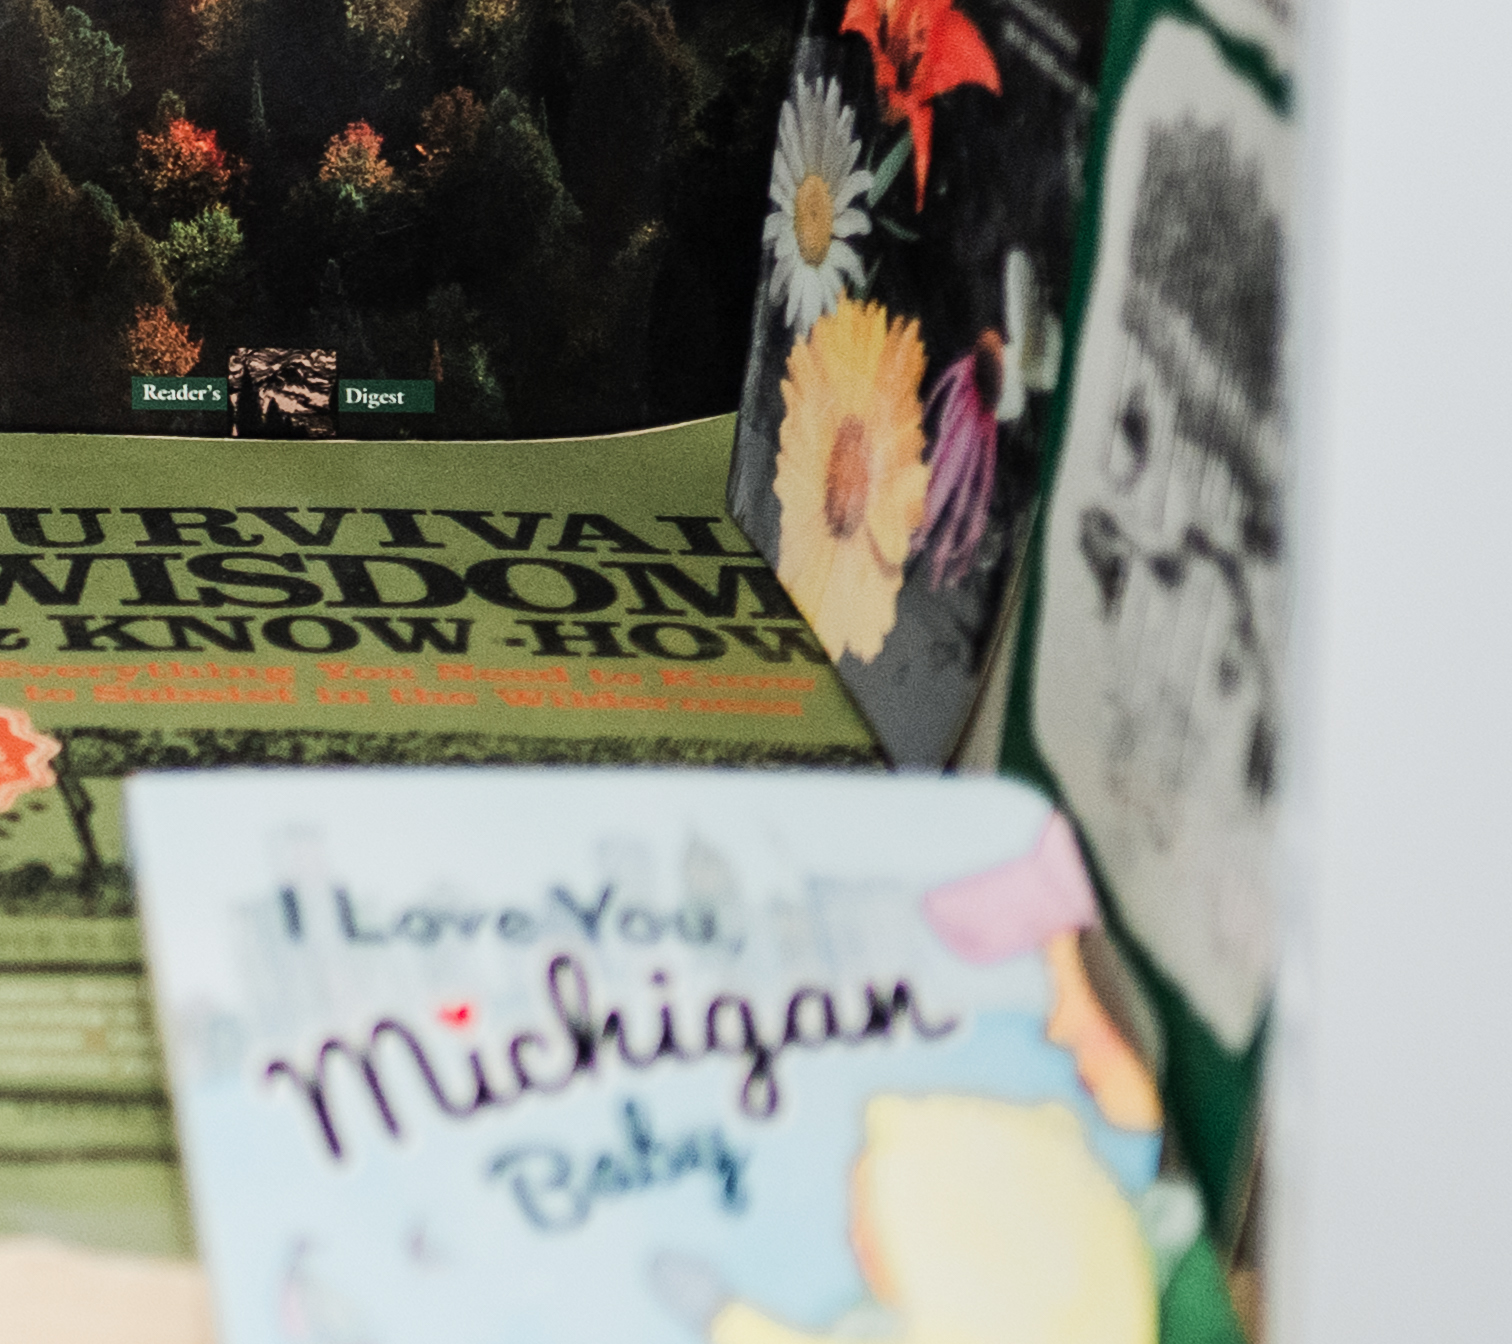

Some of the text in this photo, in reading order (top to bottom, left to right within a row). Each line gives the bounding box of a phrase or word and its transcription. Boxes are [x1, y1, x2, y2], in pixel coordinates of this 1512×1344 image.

[142, 384, 405, 409] Reader's Digest
[24, 683, 77, 703] to
[316, 684, 370, 705] in
[389, 685, 479, 706] the
[493, 687, 804, 716] Wilderness
[316, 661, 422, 682] You
[436, 663, 570, 685] Need
[588, 668, 643, 686] to
[662, 668, 816, 692] Know
[281, 882, 746, 956] I Love You,
[262, 953, 958, 1164] Michigan
[484, 1095, 752, 1233] Baby
